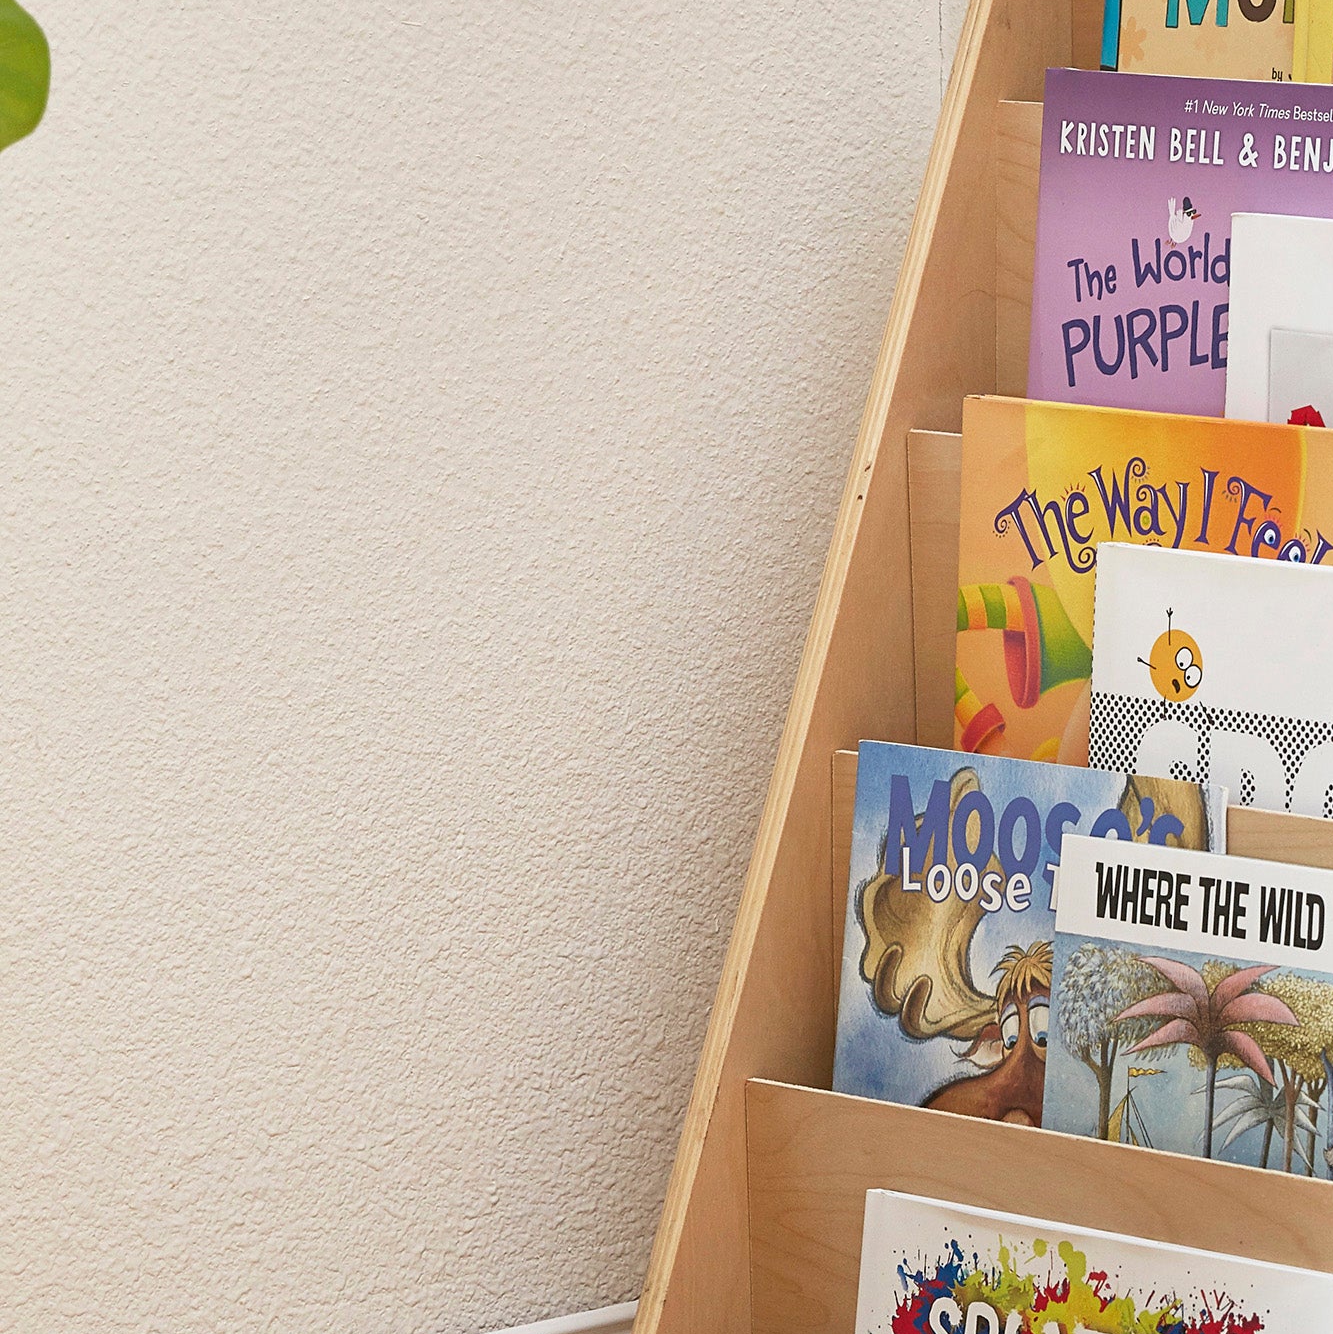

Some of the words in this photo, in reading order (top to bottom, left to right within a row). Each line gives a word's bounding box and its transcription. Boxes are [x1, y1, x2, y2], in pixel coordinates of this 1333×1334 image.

[1184, 99, 1199, 113] #1
[1202, 100, 1228, 115] New
[1232, 101, 1255, 117] York
[1258, 103, 1291, 120] Times
[1271, 68, 1283, 81] by
[1059, 120, 1156, 161] KRISTEN
[1169, 128, 1224, 166] BELL
[1238, 133, 1259, 169] &
[1067, 258, 1117, 302] The
[1131, 232, 1231, 288] World
[1062, 300, 1229, 387] PURPLE
[993, 487, 1097, 573] The
[1088, 456, 1190, 548] Way
[1195, 467, 1220, 544] I
[1095, 862, 1191, 932] WHERE
[1199, 877, 1250, 938] THE
[1258, 886, 1325, 951] WILD
